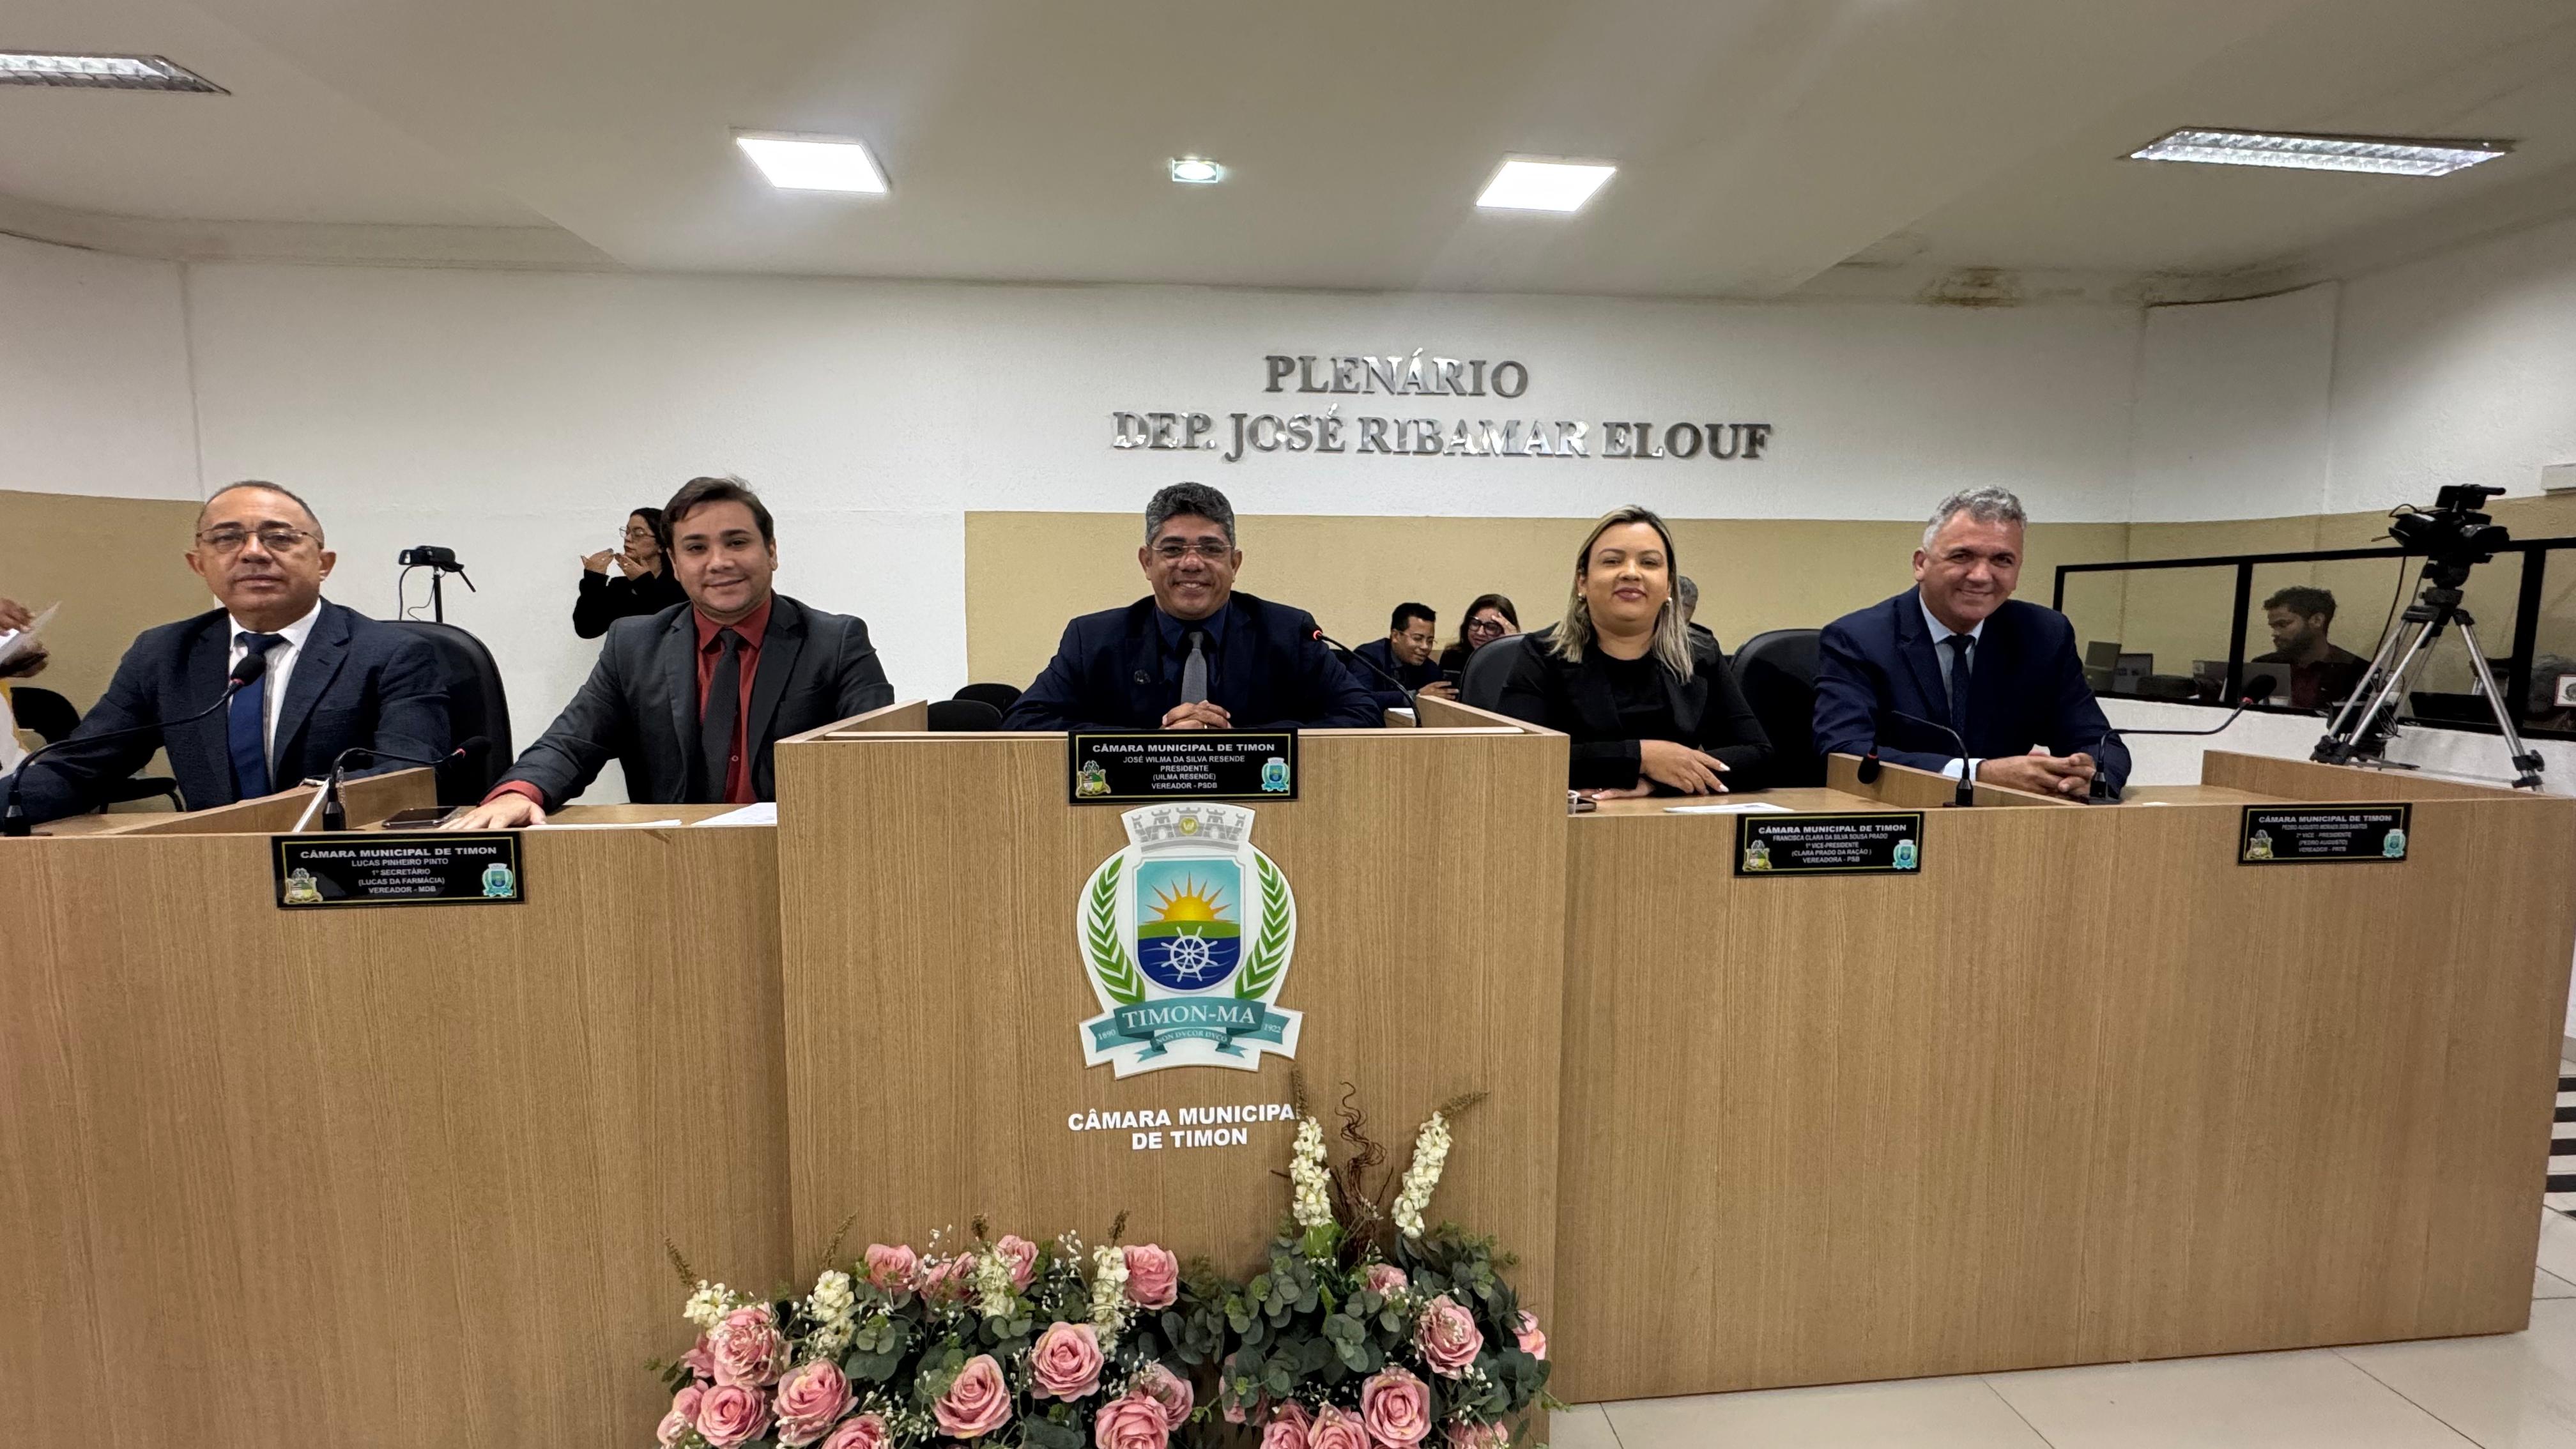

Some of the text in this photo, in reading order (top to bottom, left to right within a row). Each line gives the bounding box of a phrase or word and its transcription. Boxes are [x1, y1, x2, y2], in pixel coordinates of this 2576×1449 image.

[1263, 347, 1529, 399] PLENÁRIO
[1113, 402, 1772, 461] DEP. JOSÉ RIBAMAR ELOUF
[1092, 743, 1275, 753] CÂMARA MUNICIPAL DE TIMON
[1123, 755, 1144, 763] JOSÉ
[1179, 772, 1216, 781] RESENDE)
[1758, 825, 1801, 834] CÂMARA
[1803, 825, 1857, 833] MUNICIPAL
[300, 847, 497, 859] CÂMARA MUNICIPAL DE TIMON
[352, 859, 381, 867] LUCAS
[380, 867, 431, 876] SECRETÁRIO
[358, 878, 388, 886] (LUCAS
[1122, 1004, 1257, 1029] TIMON-MA
[1098, 1029, 1117, 1040] 1890
[1155, 1032, 1174, 1044] NON
[1068, 1108, 1172, 1131] CÂMARA
[1131, 1128, 1248, 1150] DE TIMON
